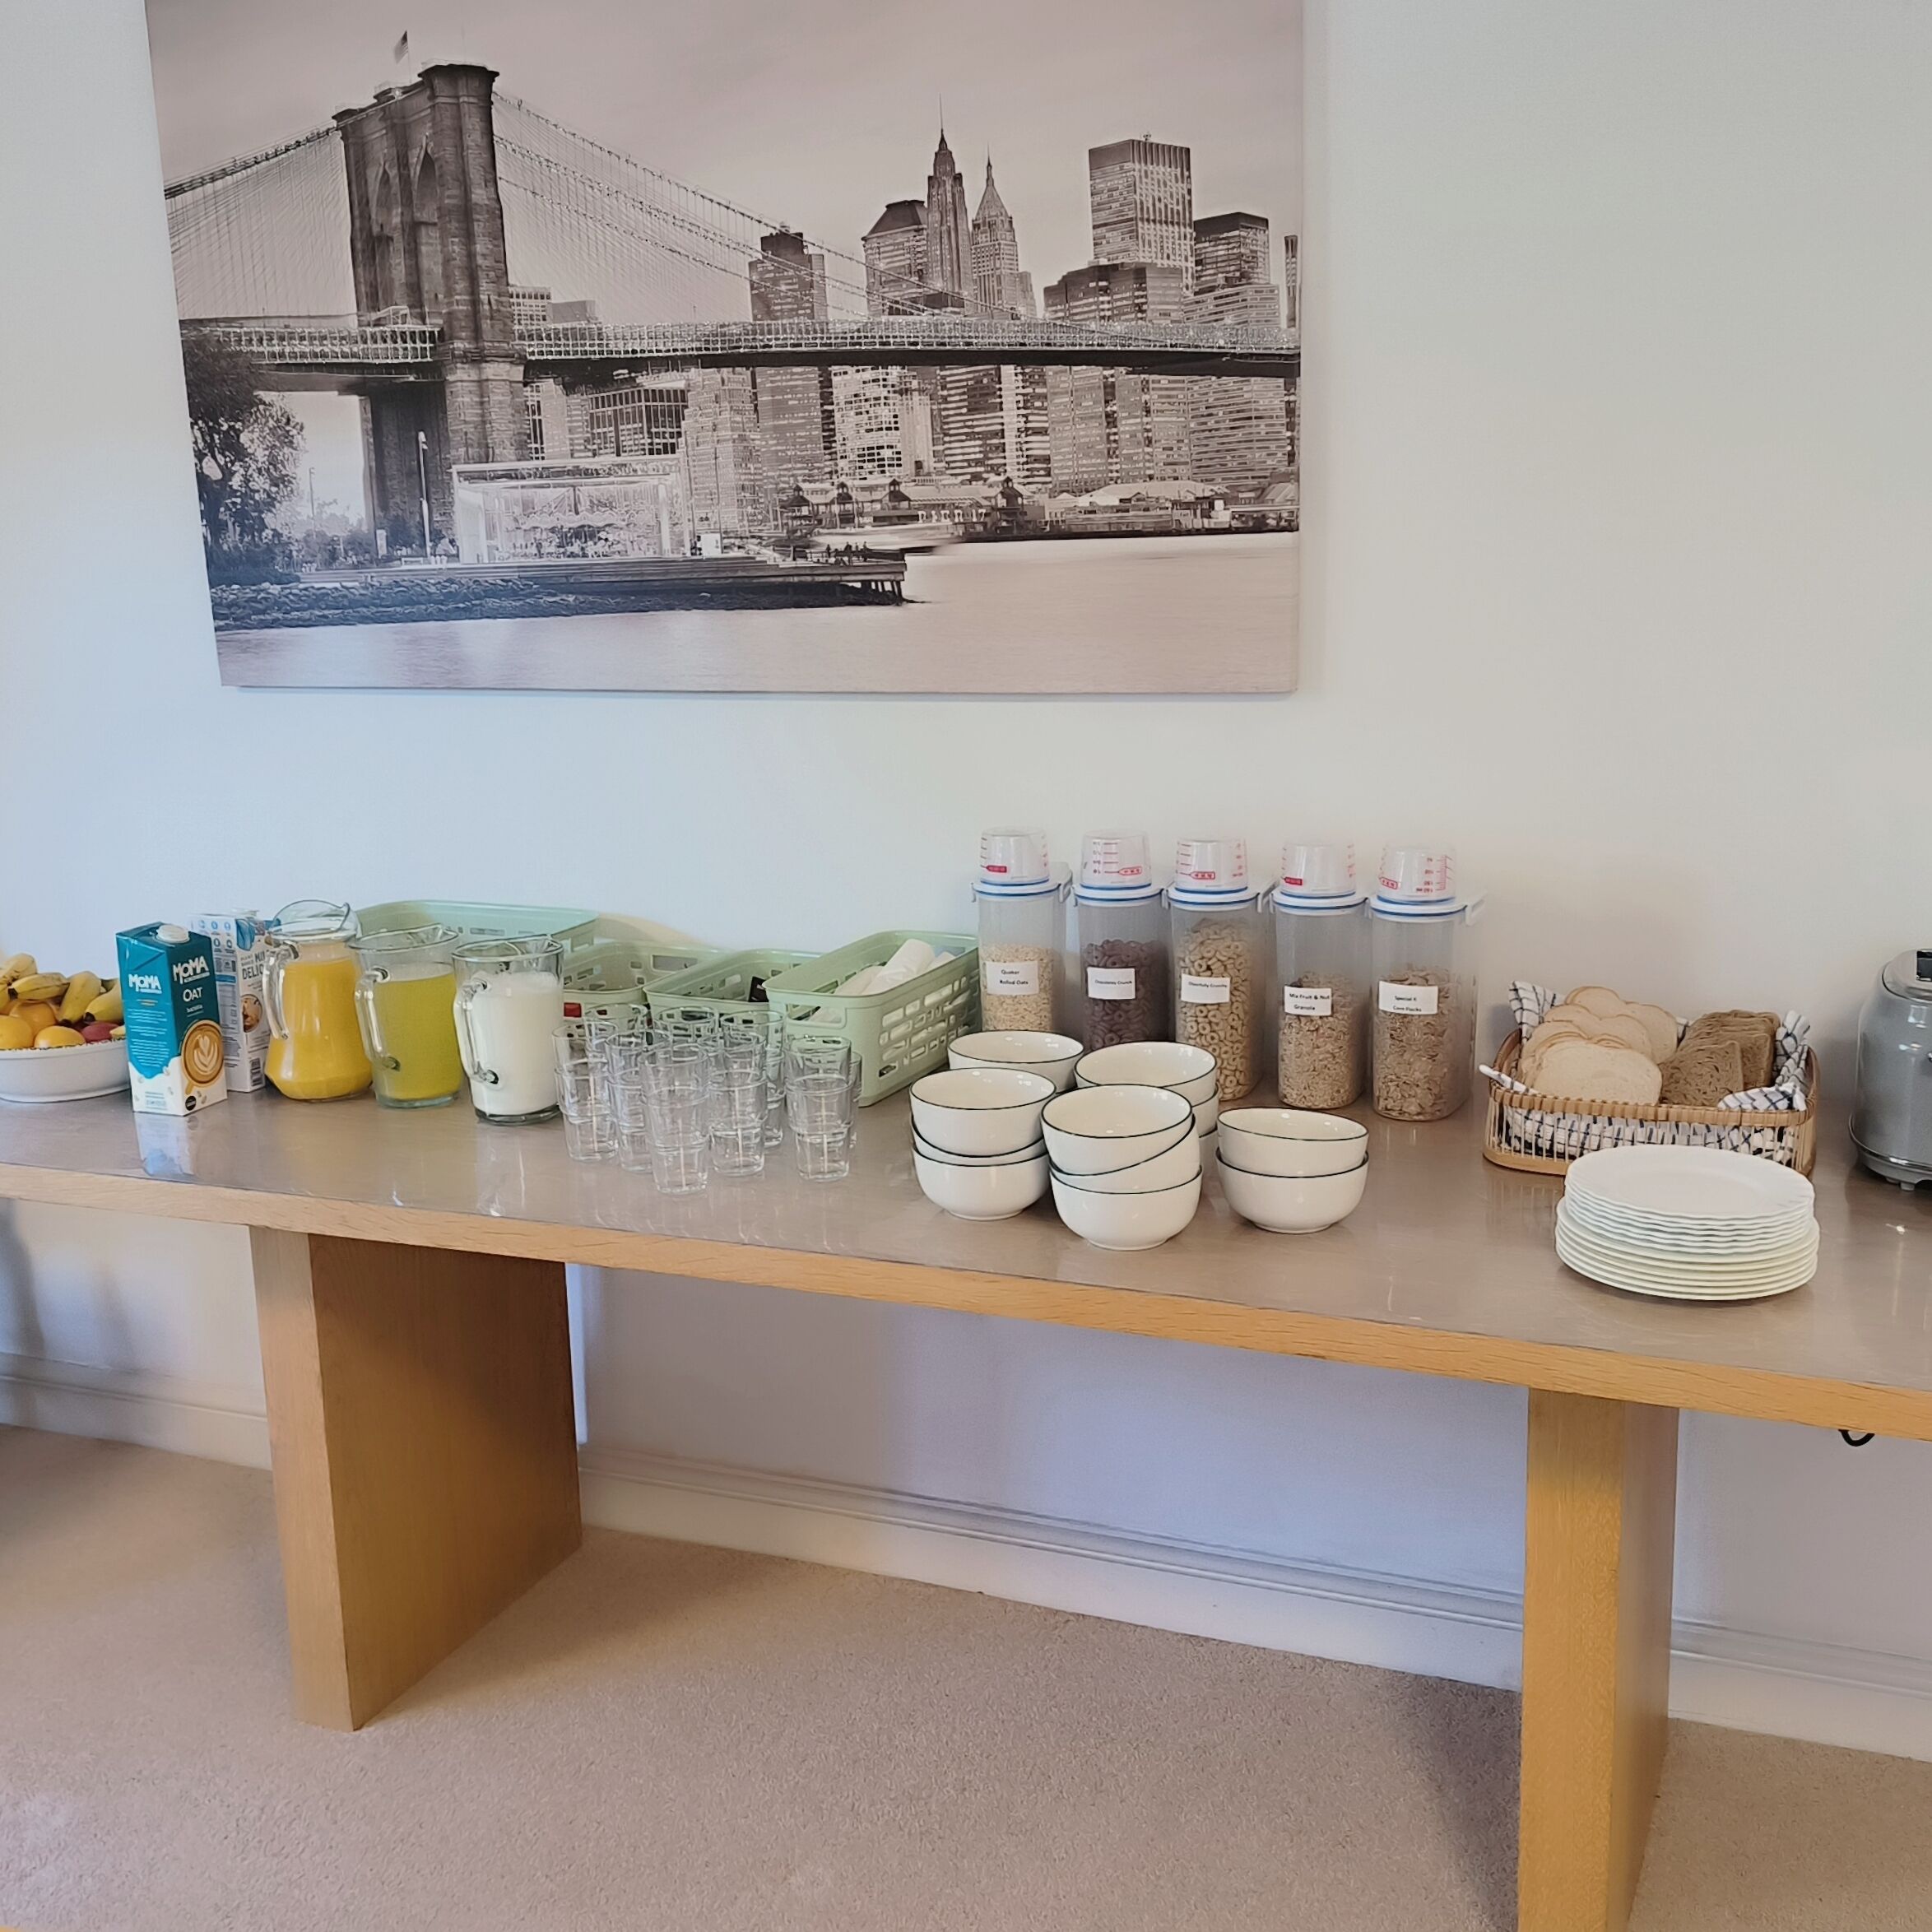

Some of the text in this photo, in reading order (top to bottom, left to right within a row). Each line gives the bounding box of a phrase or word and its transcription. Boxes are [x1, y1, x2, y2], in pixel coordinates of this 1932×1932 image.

[972, 509, 987, 522] 17
[172, 955, 211, 985] MOMA
[128, 973, 163, 993] MOMA
[183, 987, 203, 1002] OAT
